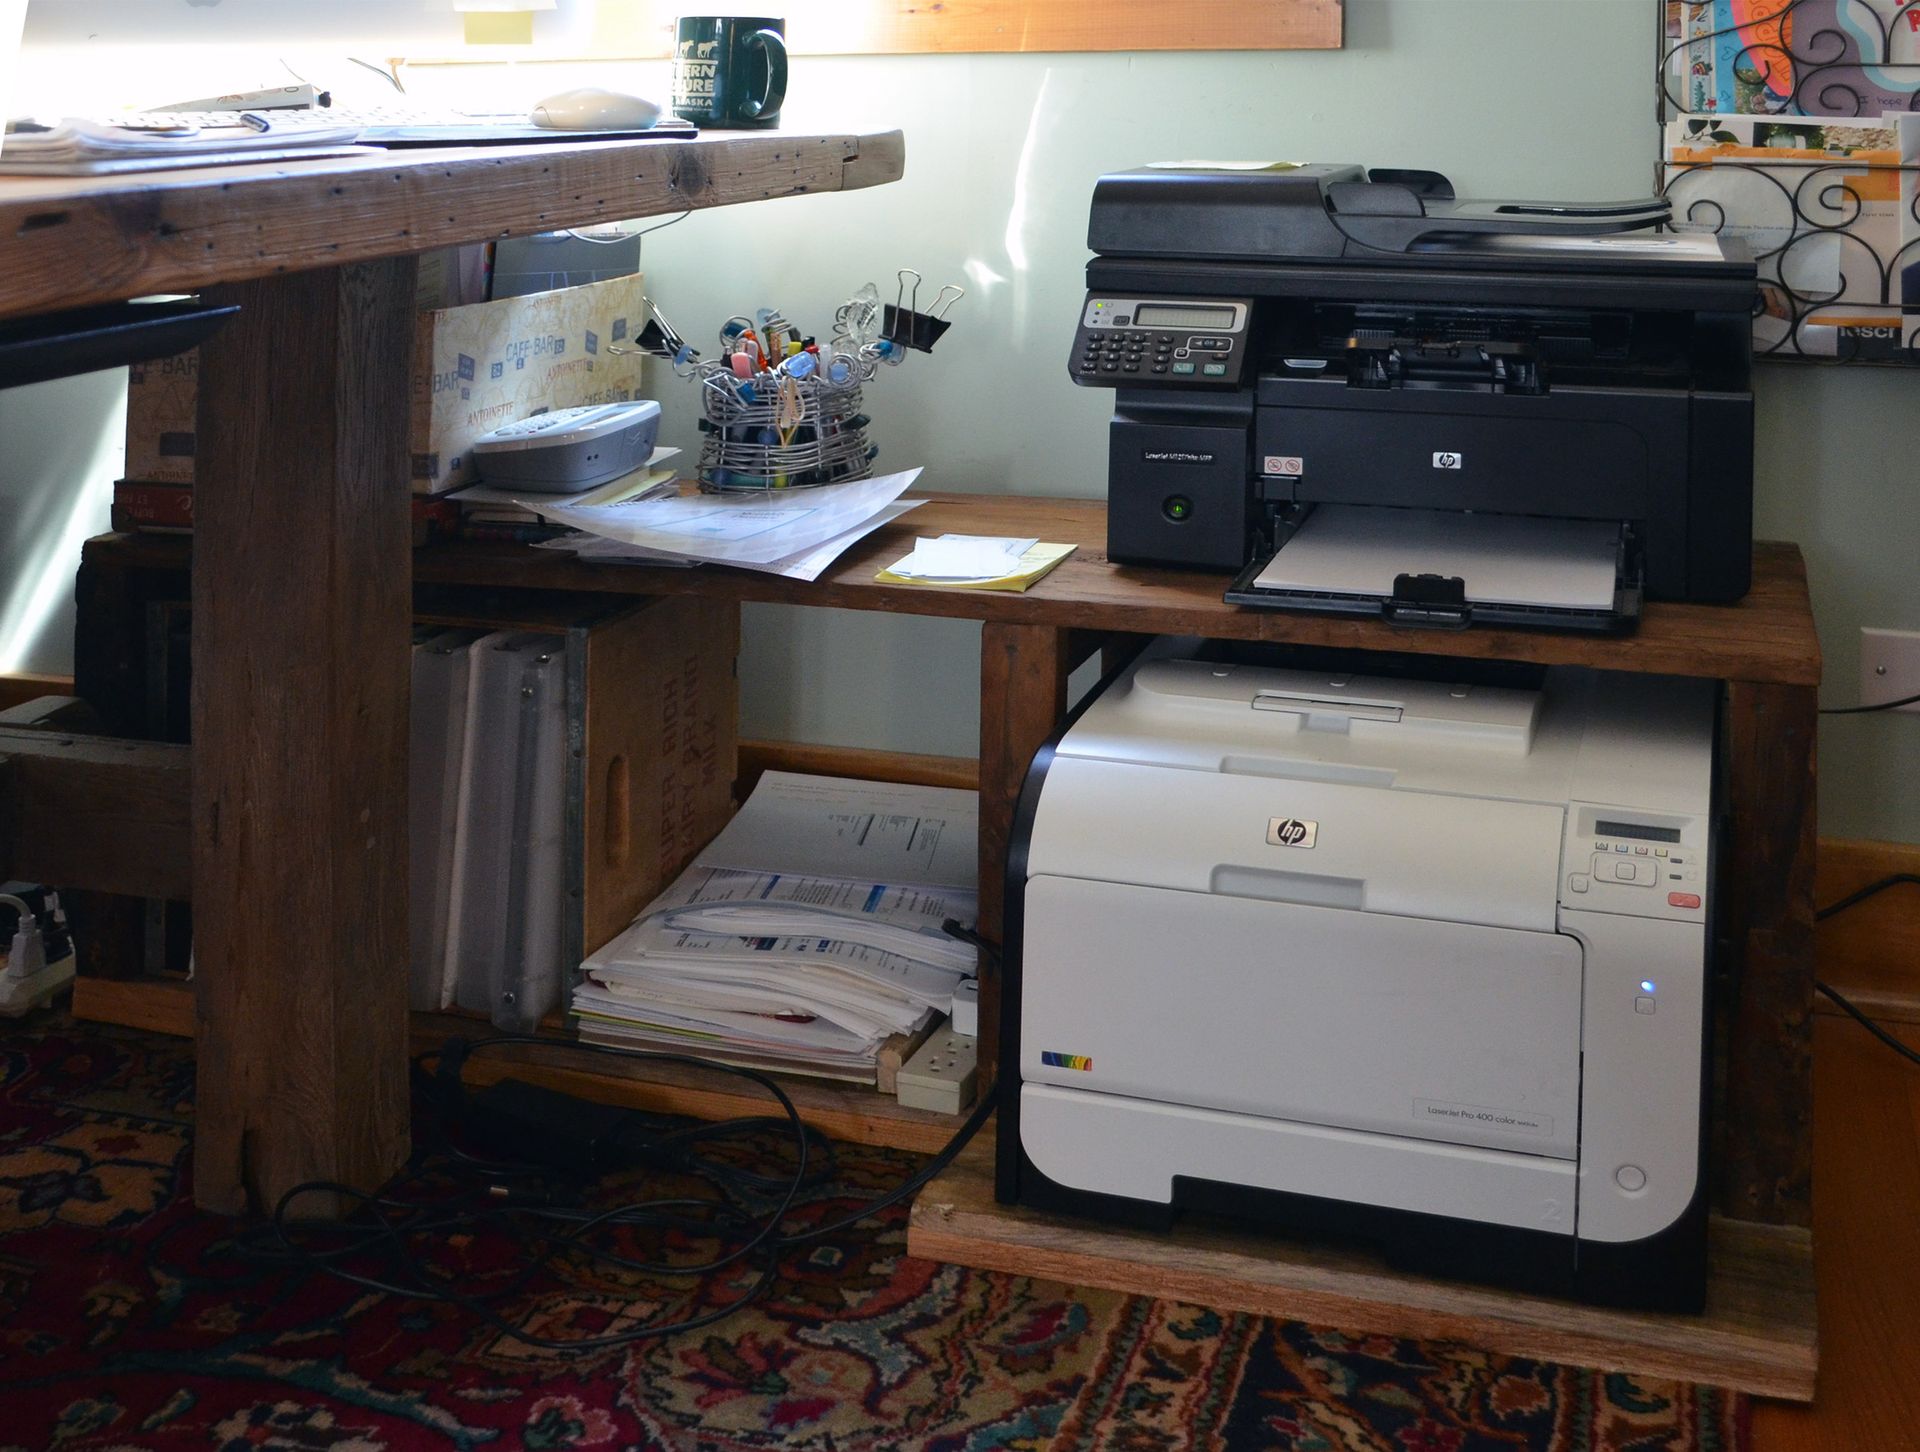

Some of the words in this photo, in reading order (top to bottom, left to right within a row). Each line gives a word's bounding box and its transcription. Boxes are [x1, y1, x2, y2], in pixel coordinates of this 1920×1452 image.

[1461, 1110, 1475, 1120] Pro
[1476, 1113, 1494, 1122] 400
[1495, 1115, 1516, 1125] color
